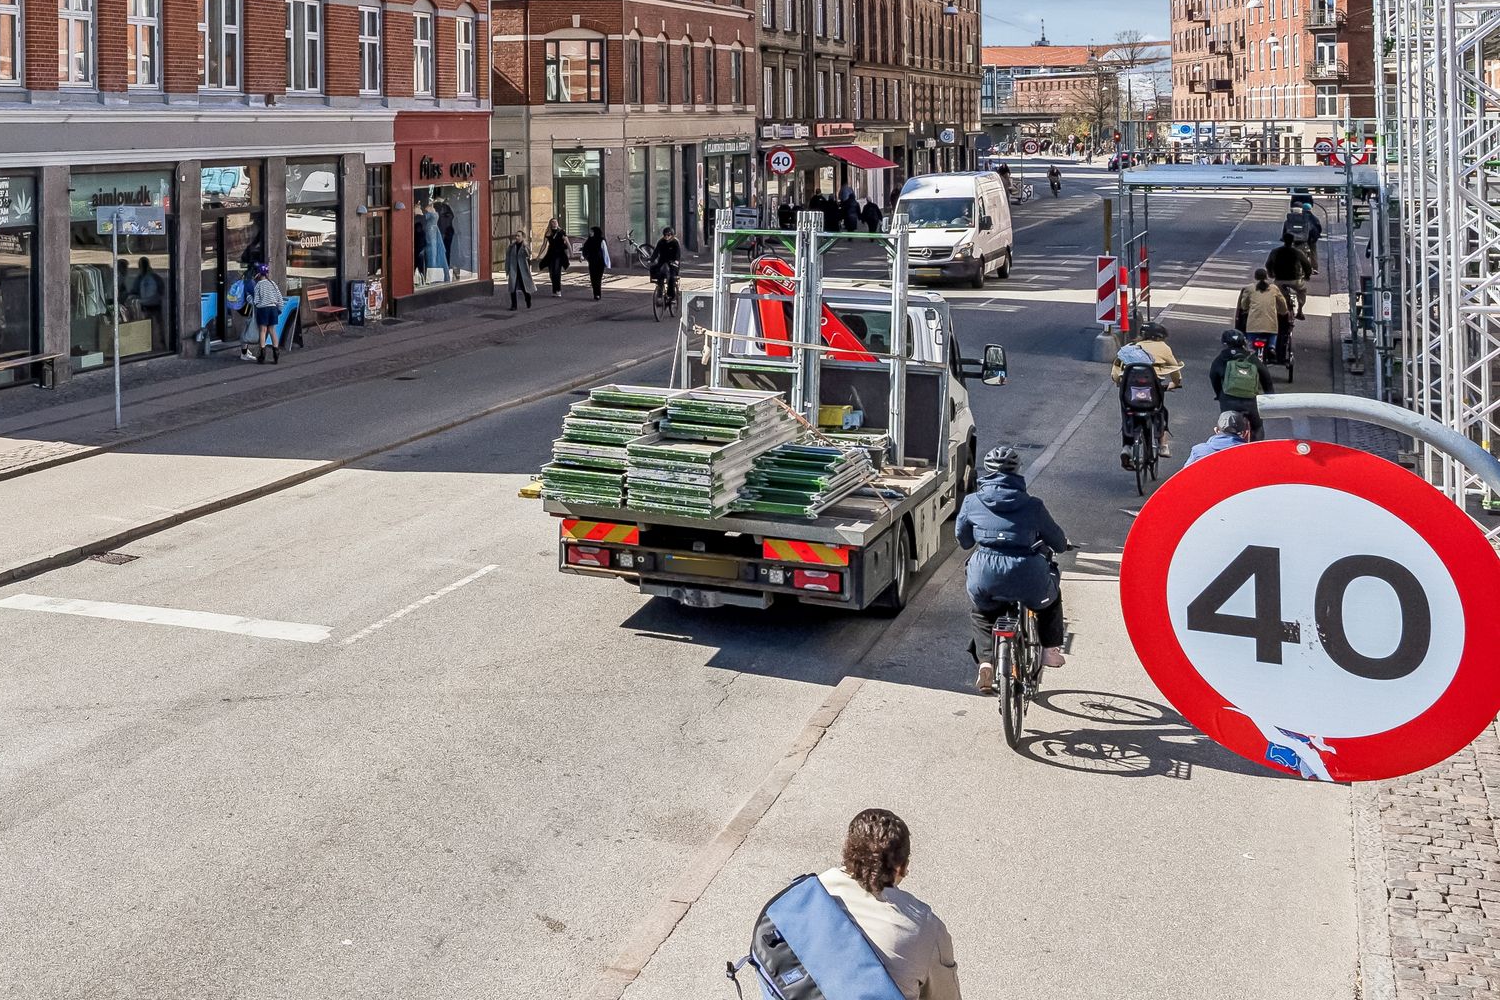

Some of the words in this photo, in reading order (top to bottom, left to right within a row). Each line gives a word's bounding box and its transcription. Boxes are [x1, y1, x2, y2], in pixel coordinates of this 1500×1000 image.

[772, 156, 791, 167] 40
[92, 185, 151, 205] aimlow.dk
[1186, 544, 1432, 681] 40
